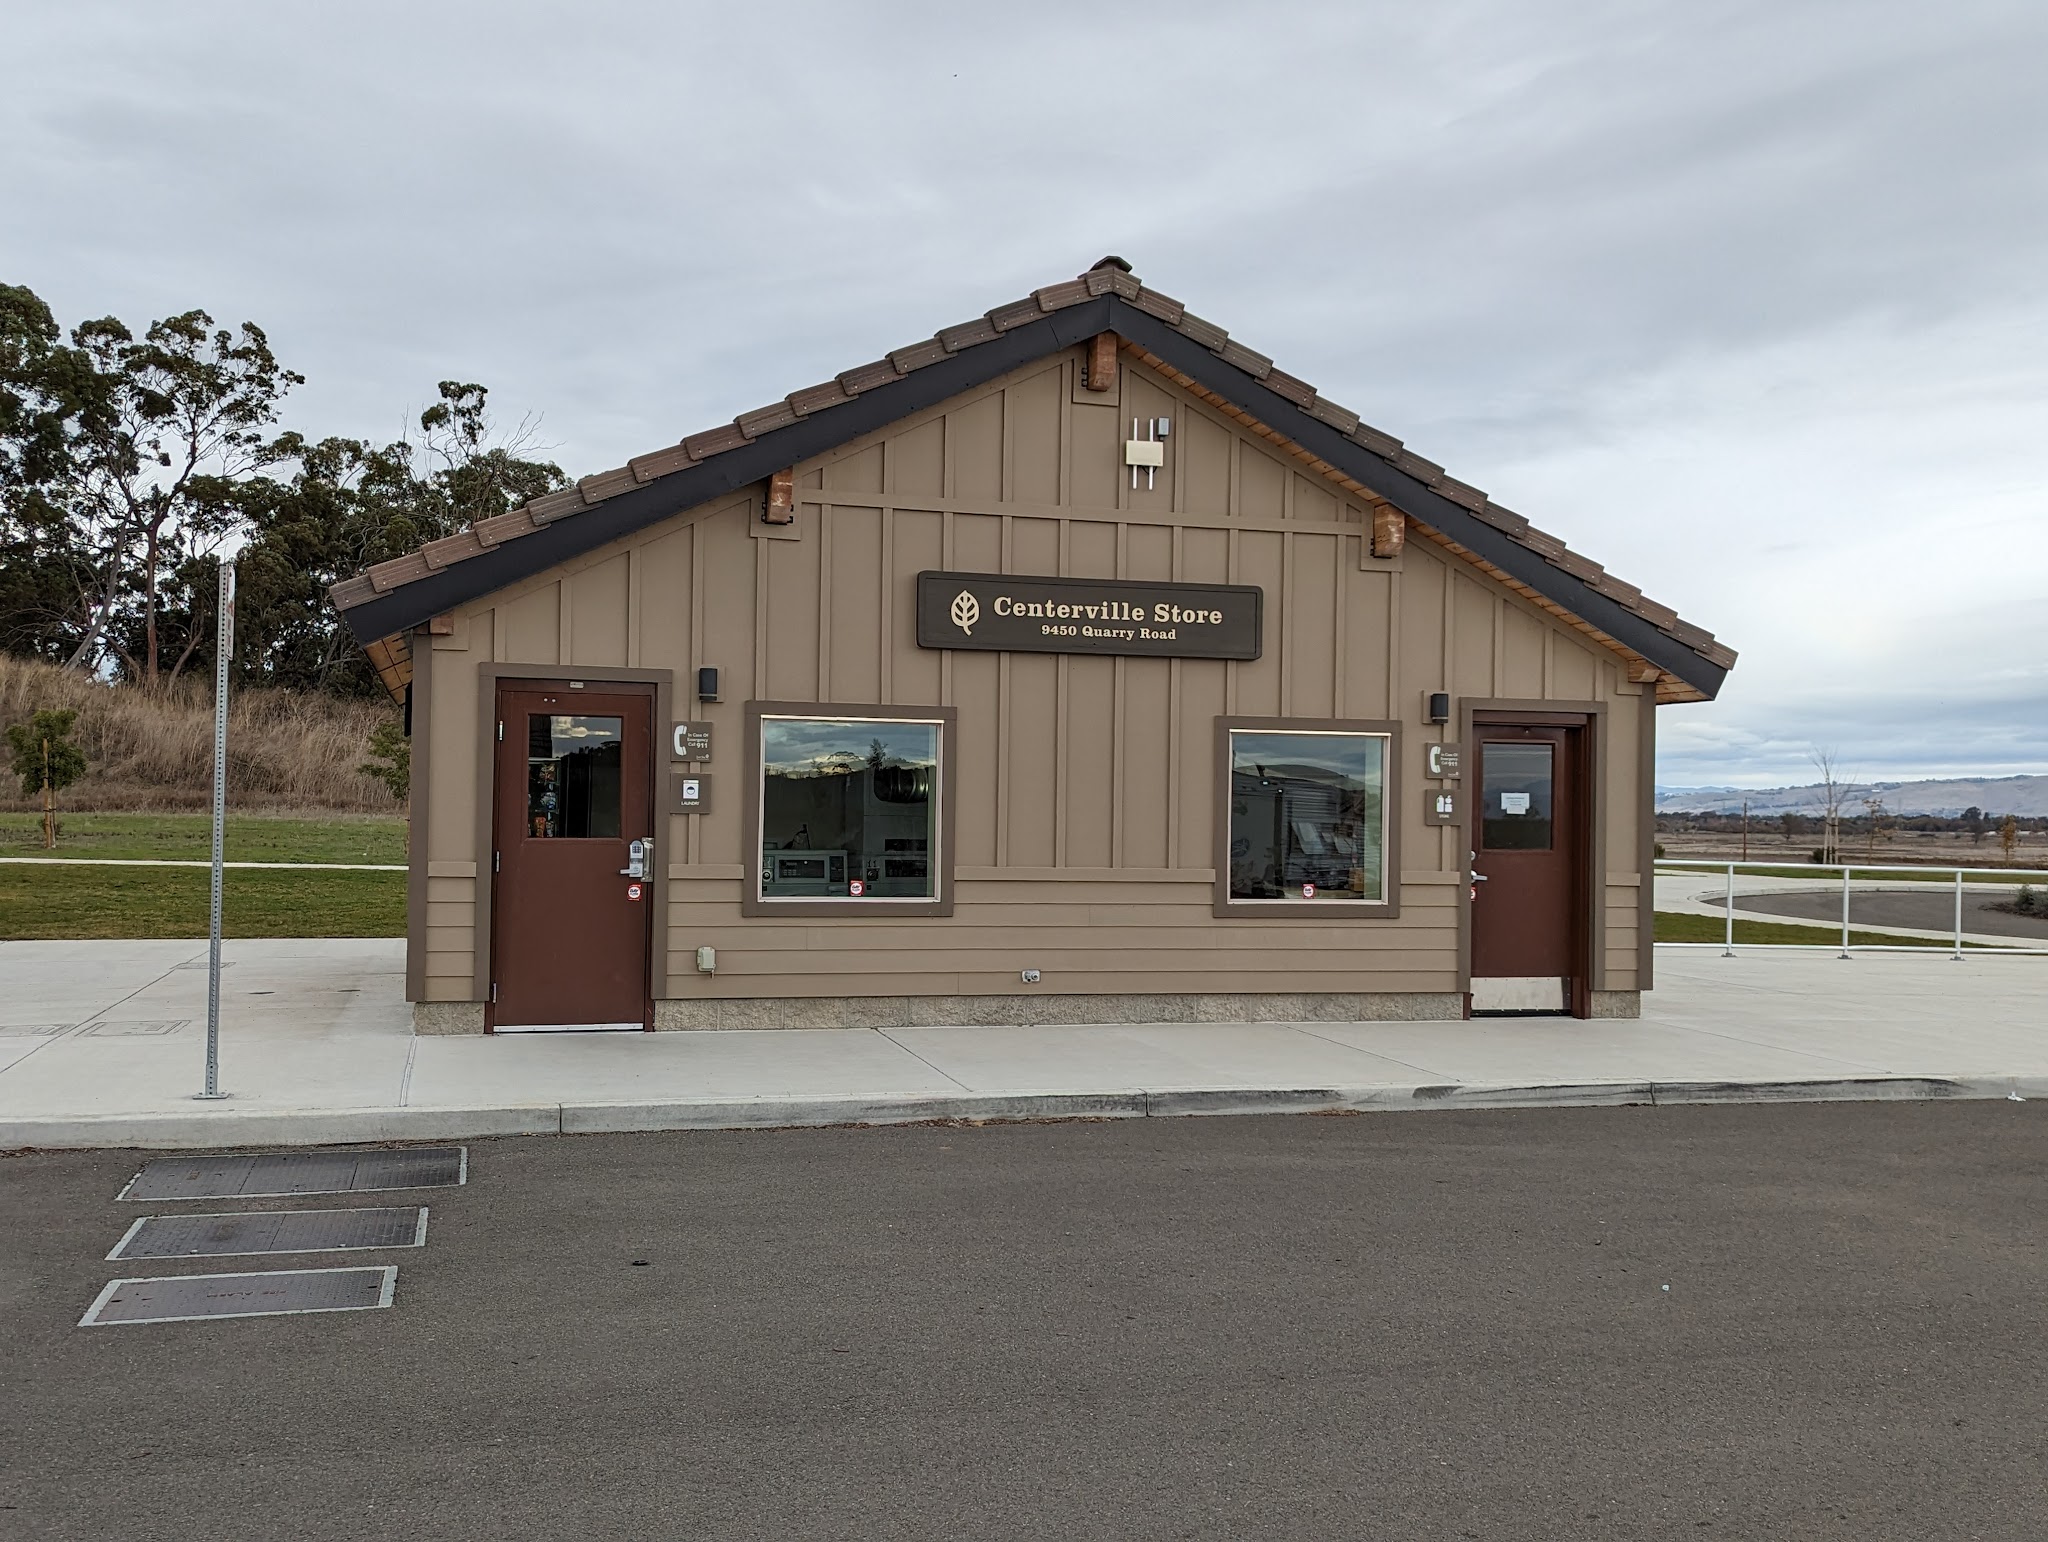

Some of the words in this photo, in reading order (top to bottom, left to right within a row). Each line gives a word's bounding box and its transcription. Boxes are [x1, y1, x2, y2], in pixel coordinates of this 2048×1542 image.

[994, 597, 1145, 622] Centerville
[1154, 603, 1223, 625] Store
[1041, 625, 1077, 636] 9450
[1082, 625, 1135, 641] Quarry
[1140, 627, 1177, 640] Road
